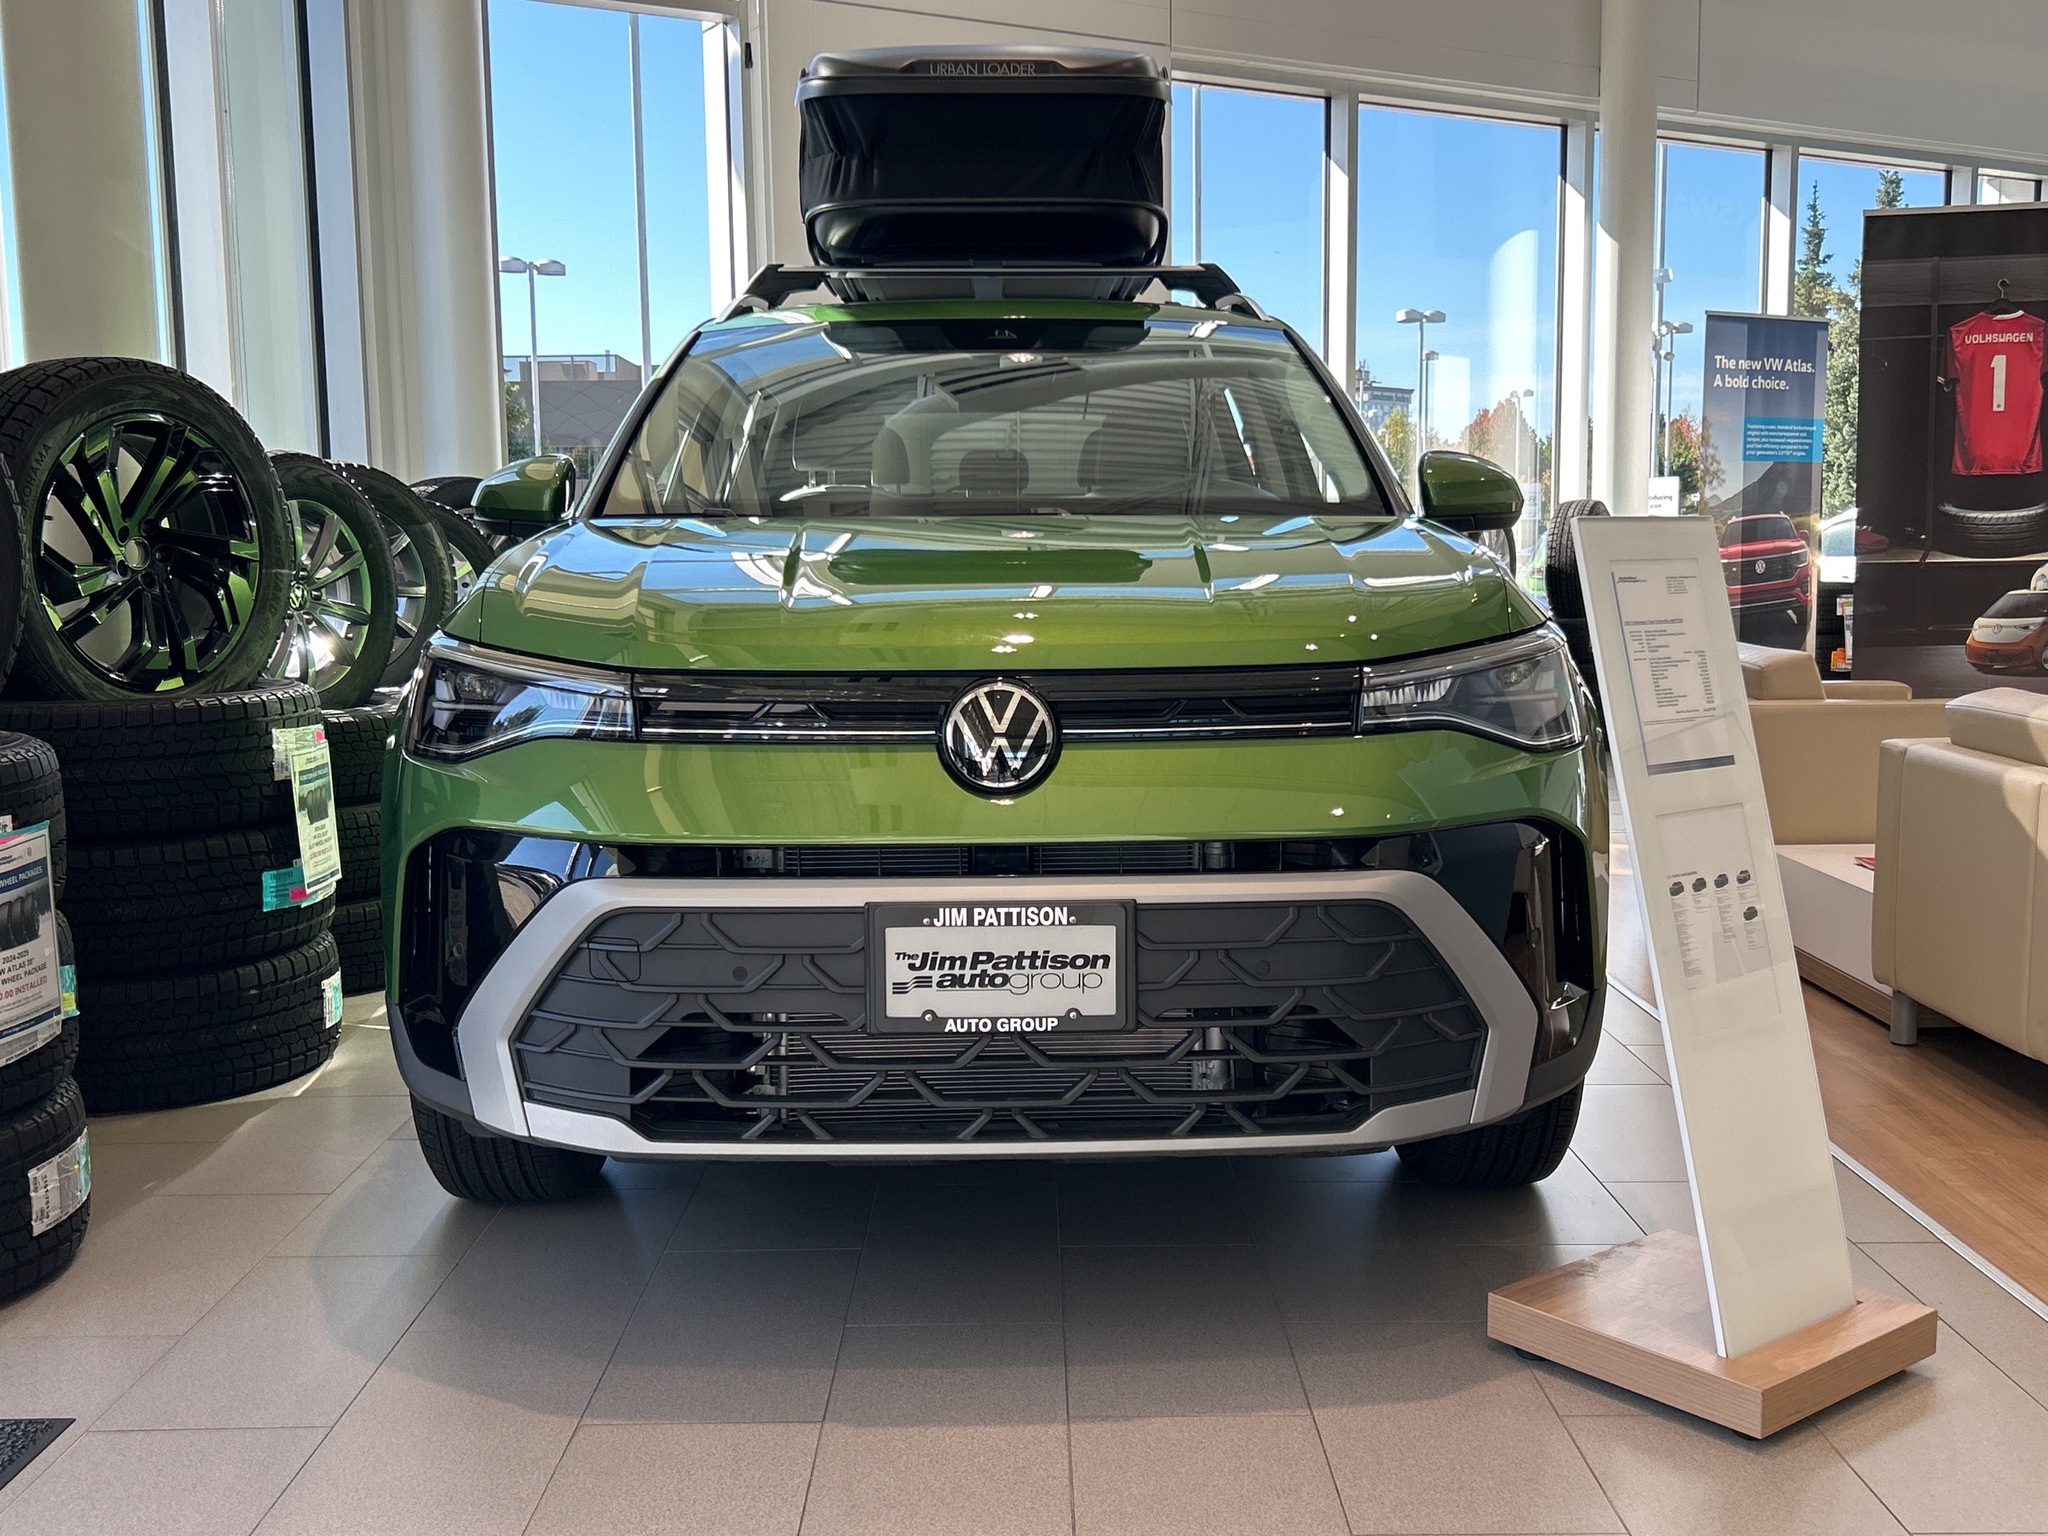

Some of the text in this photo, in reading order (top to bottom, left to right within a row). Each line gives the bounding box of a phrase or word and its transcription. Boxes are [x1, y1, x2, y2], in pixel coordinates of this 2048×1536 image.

[930, 63, 1036, 76] URBAN LOADER
[1964, 332, 2034, 345] VOLKSWAGEN
[1715, 355, 1815, 374] The new VW Atlas.
[1713, 374, 1790, 390] A bold choice.
[1990, 354, 2007, 411] 1
[21, 442, 53, 519] OKOHAMA
[933, 906, 1068, 927] JIM PATTISON
[7, 960, 26, 974] ATLAS
[895, 950, 1111, 972] The Jim Pattison
[1, 973, 23, 985] WHEEL
[15, 975, 48, 996] INSTALLED
[936, 968, 1103, 995] autogroup
[944, 1017, 1059, 1033] AUTO GROUP
